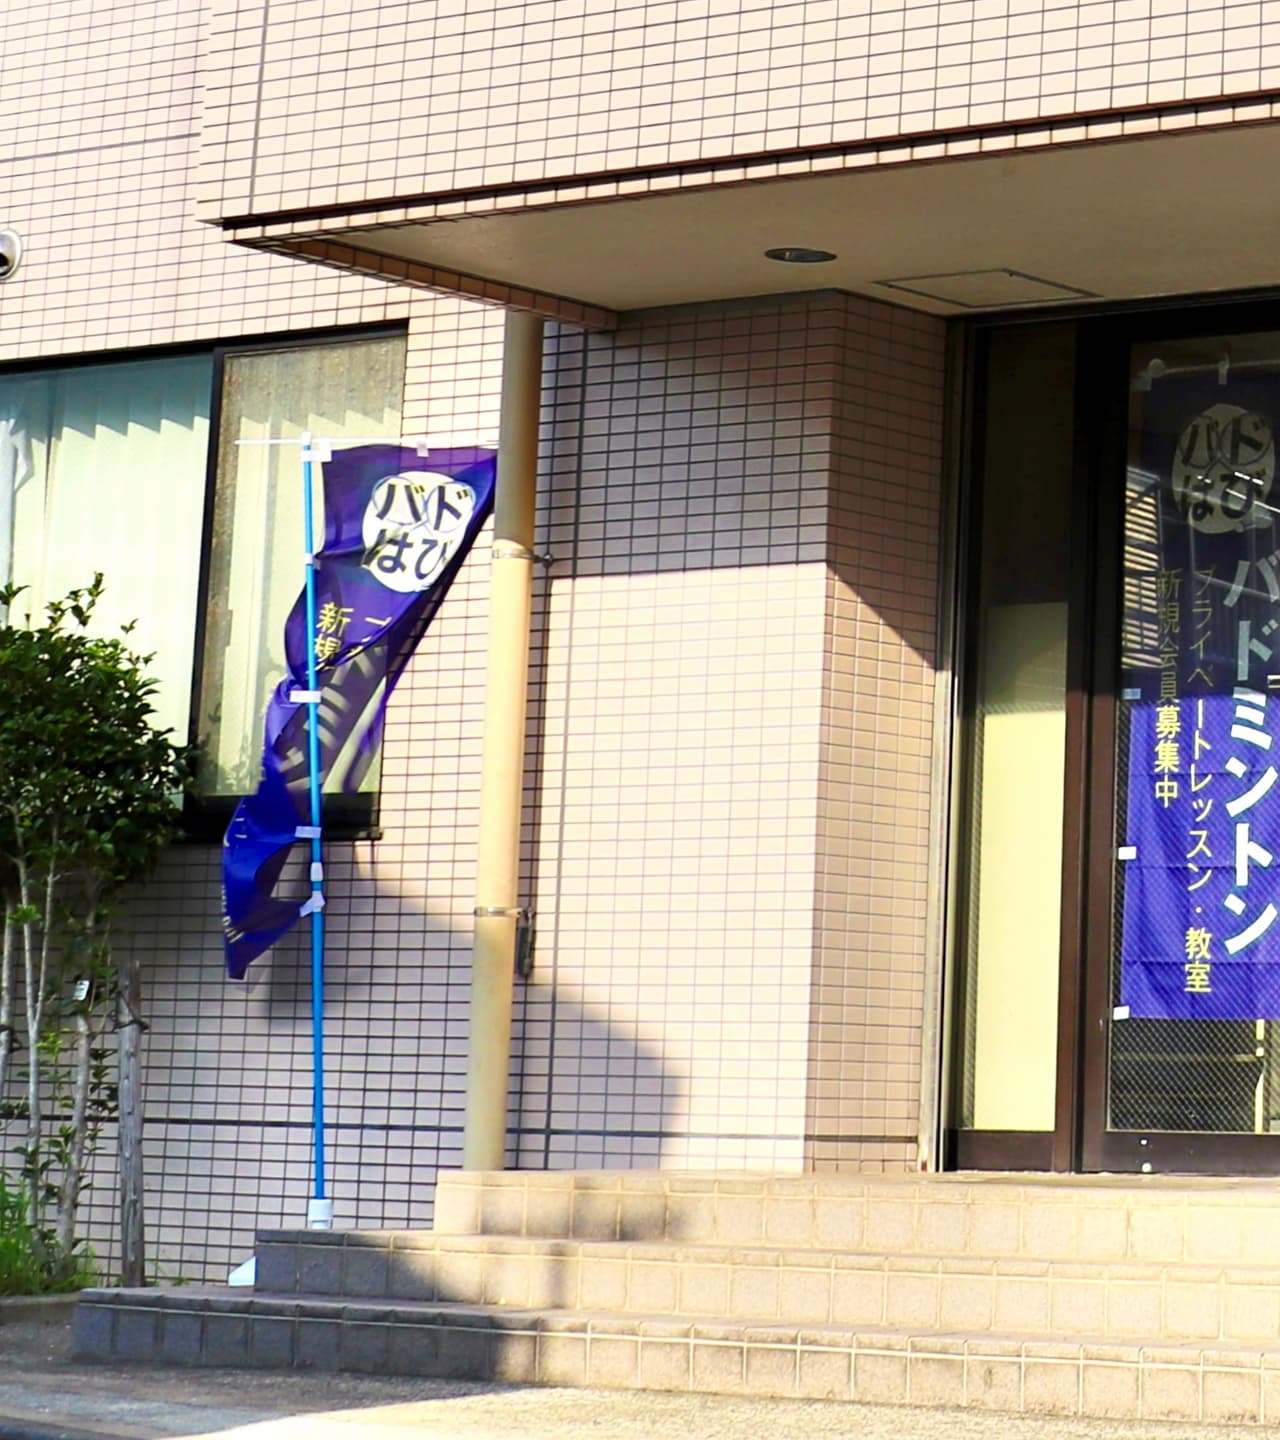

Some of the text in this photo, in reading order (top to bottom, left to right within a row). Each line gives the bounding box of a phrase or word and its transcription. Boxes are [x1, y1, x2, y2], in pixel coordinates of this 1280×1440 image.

[375, 482, 470, 530] バド
[1155, 567, 1184, 809] 新規会員募集中
